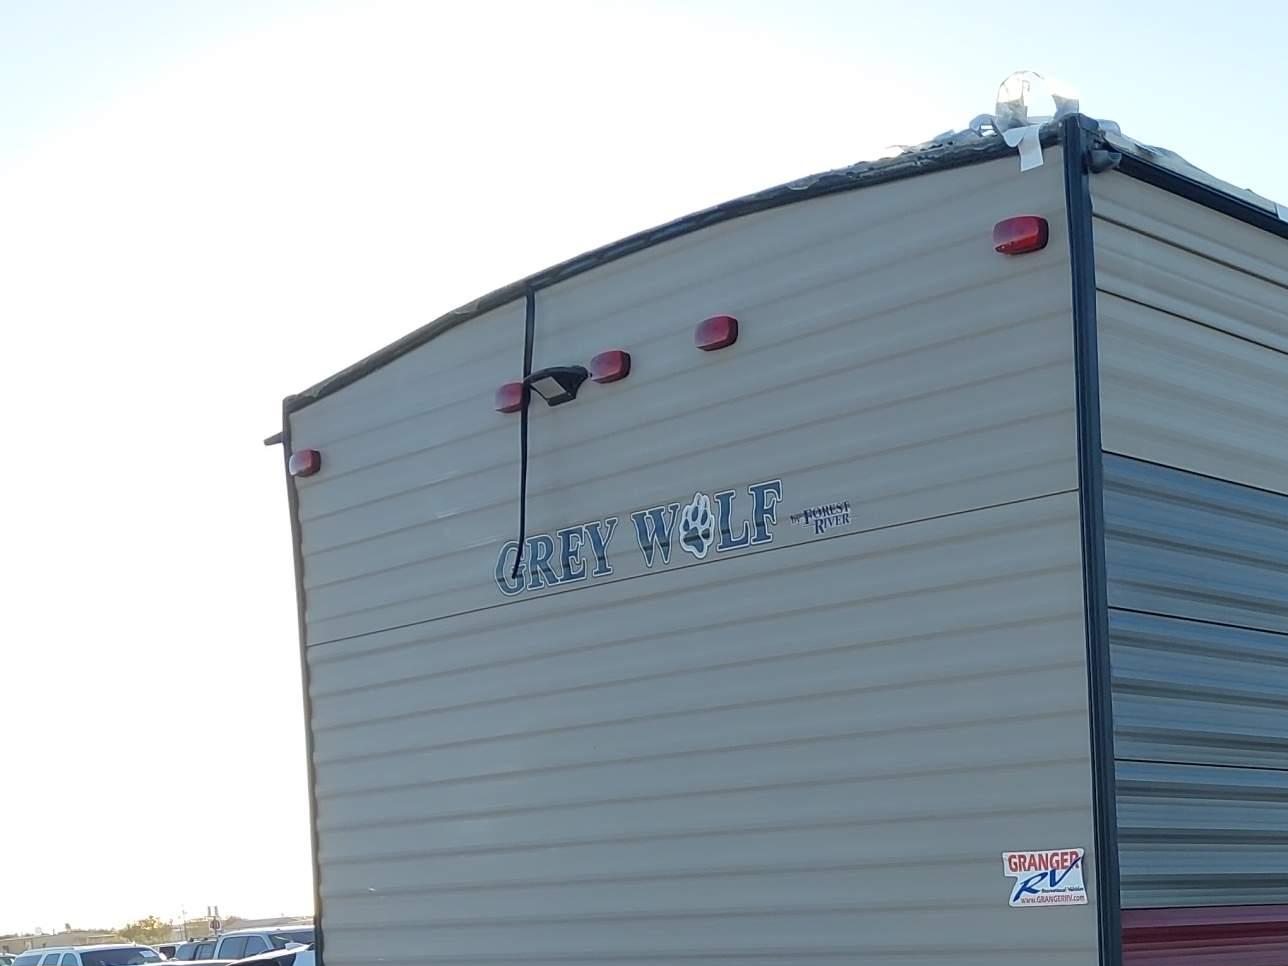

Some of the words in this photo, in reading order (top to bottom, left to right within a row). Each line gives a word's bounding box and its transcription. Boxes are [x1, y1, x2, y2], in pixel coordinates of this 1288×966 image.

[803, 500, 850, 524] FOREST
[814, 513, 850, 535] RIVER
[495, 516, 619, 596] GREY
[1008, 850, 1080, 872] GRANGER
[1012, 857, 1081, 902] RV
